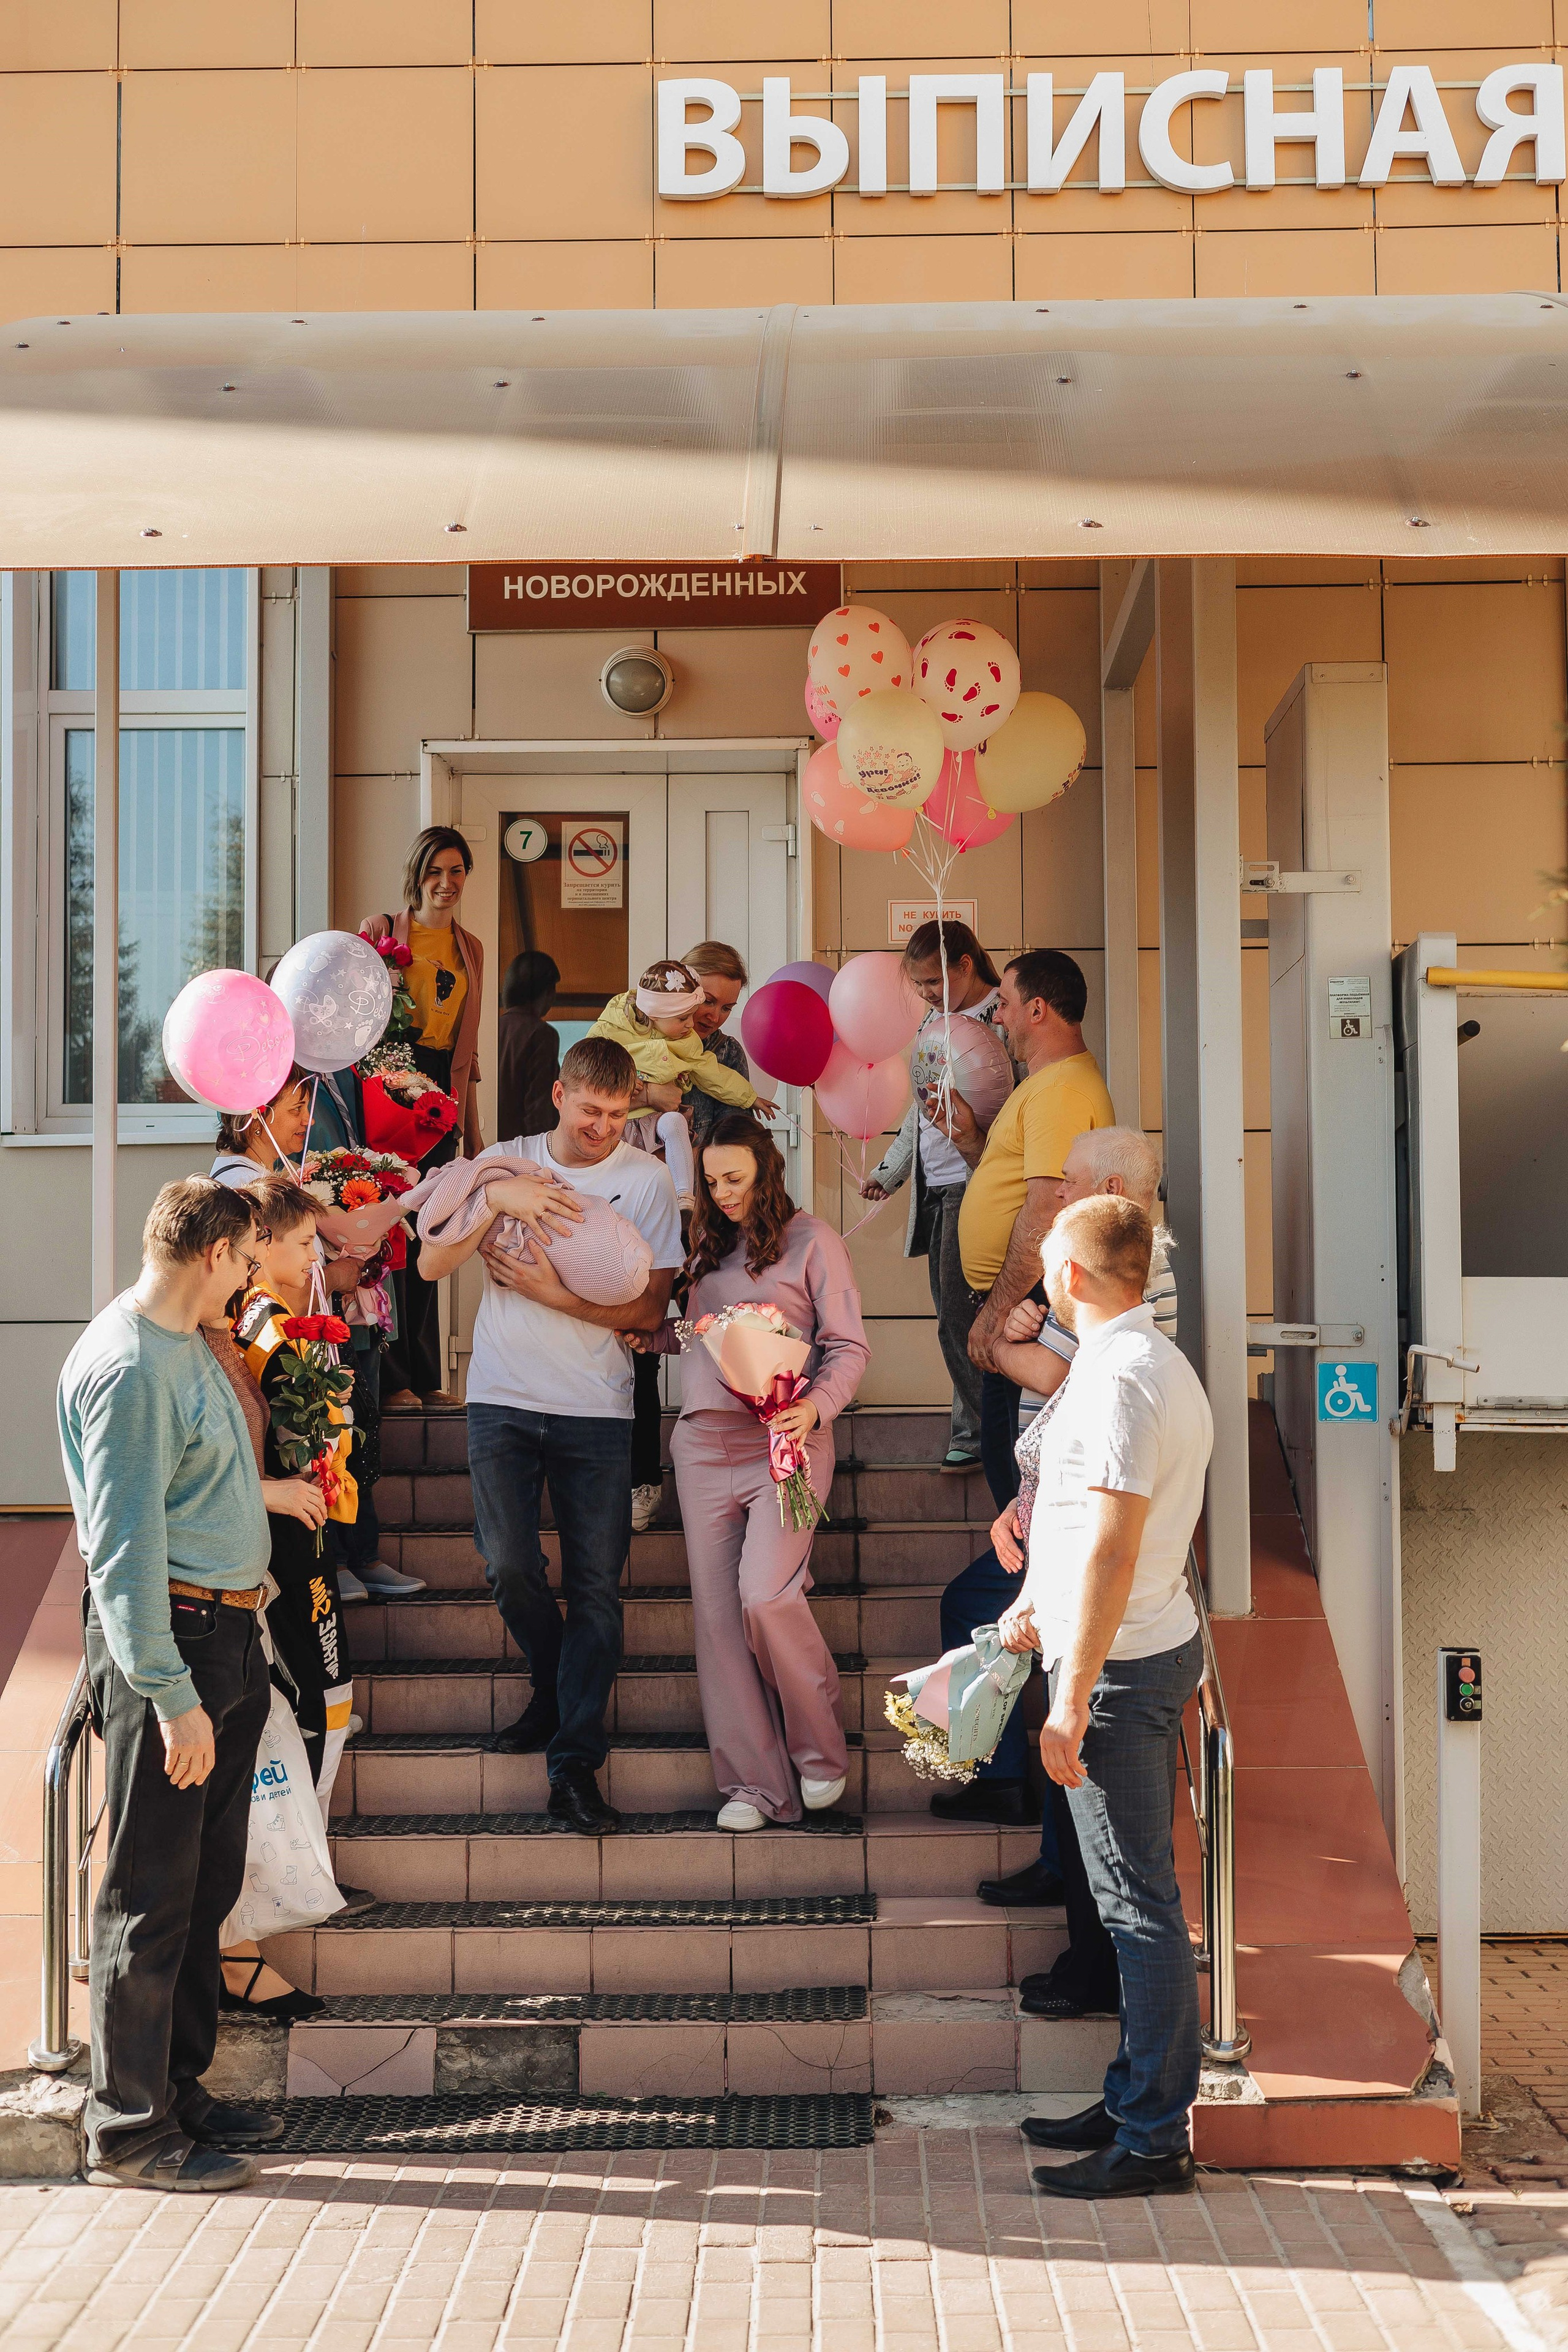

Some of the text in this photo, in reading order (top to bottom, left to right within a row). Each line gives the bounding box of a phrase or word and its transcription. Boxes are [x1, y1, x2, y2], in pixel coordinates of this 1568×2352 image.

[658, 63, 1566, 200] ВЫПИСНАЯ
[504, 571, 807, 601] НОВОРОЖДЕННЫХ
[519, 831, 533, 850] 7
[269, 1785, 292, 1801] детей
